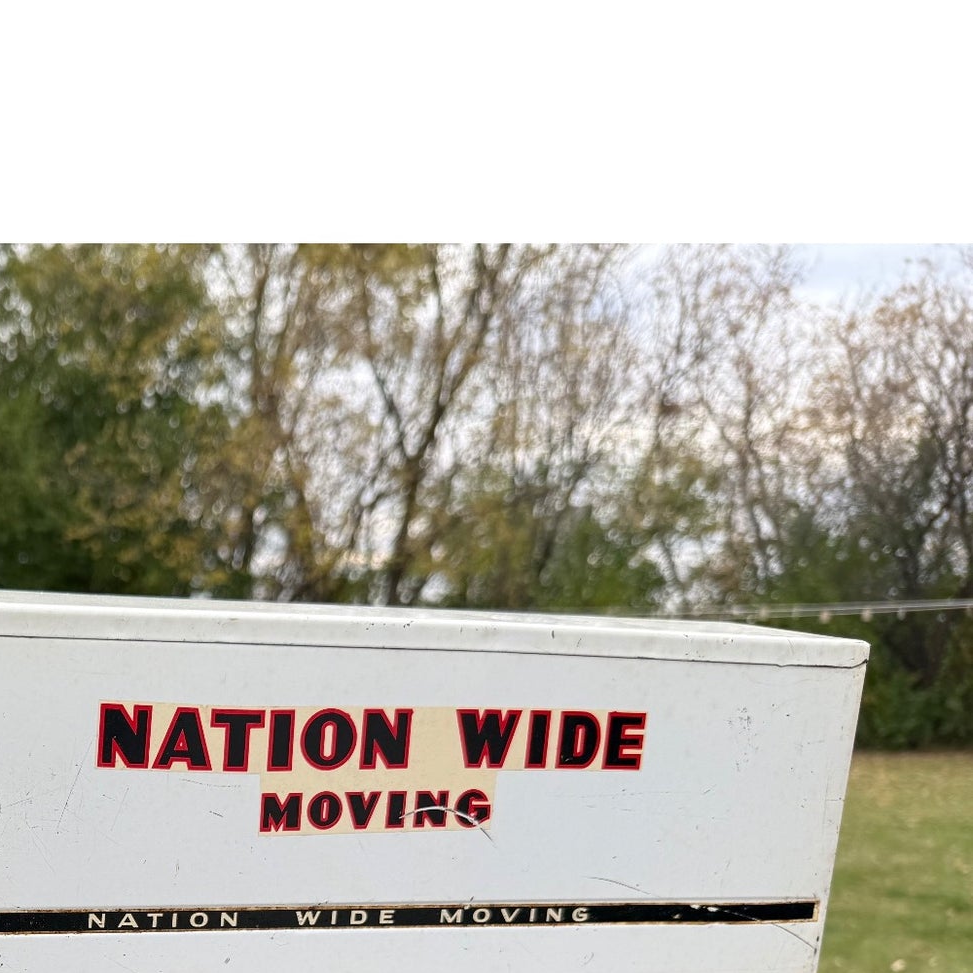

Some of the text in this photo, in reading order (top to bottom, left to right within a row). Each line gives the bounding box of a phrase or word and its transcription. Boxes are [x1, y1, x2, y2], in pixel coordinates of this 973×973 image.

[96, 703, 648, 772] NATION WIDE
[259, 789, 492, 833] MOVING
[88, 907, 589, 929] NATION WIDE MOVING
